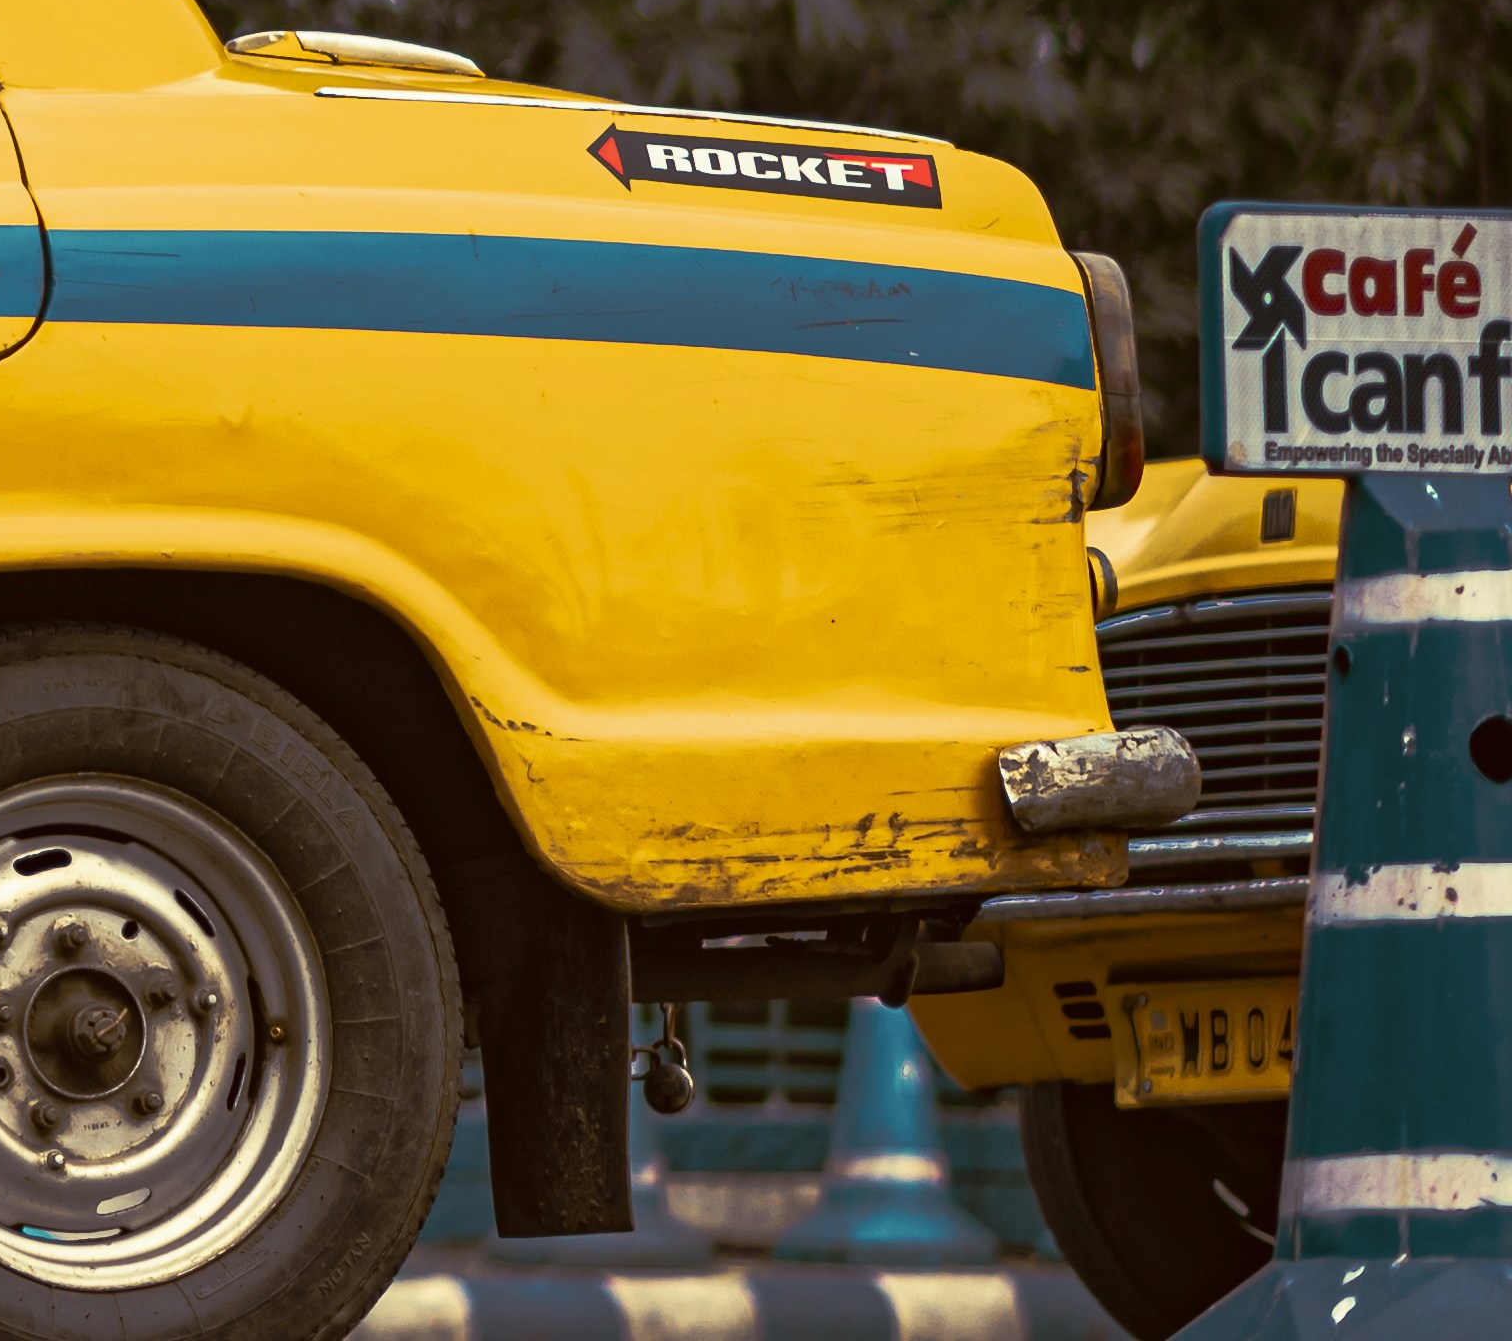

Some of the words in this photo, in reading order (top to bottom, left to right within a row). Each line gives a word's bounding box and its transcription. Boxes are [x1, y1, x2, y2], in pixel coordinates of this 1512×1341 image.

[645, 142, 914, 191] ROCKET
[1301, 221, 1482, 319] Café
[1264, 441, 1373, 467] Empowering
[1375, 443, 1404, 462] the
[1406, 443, 1485, 469] Specially
